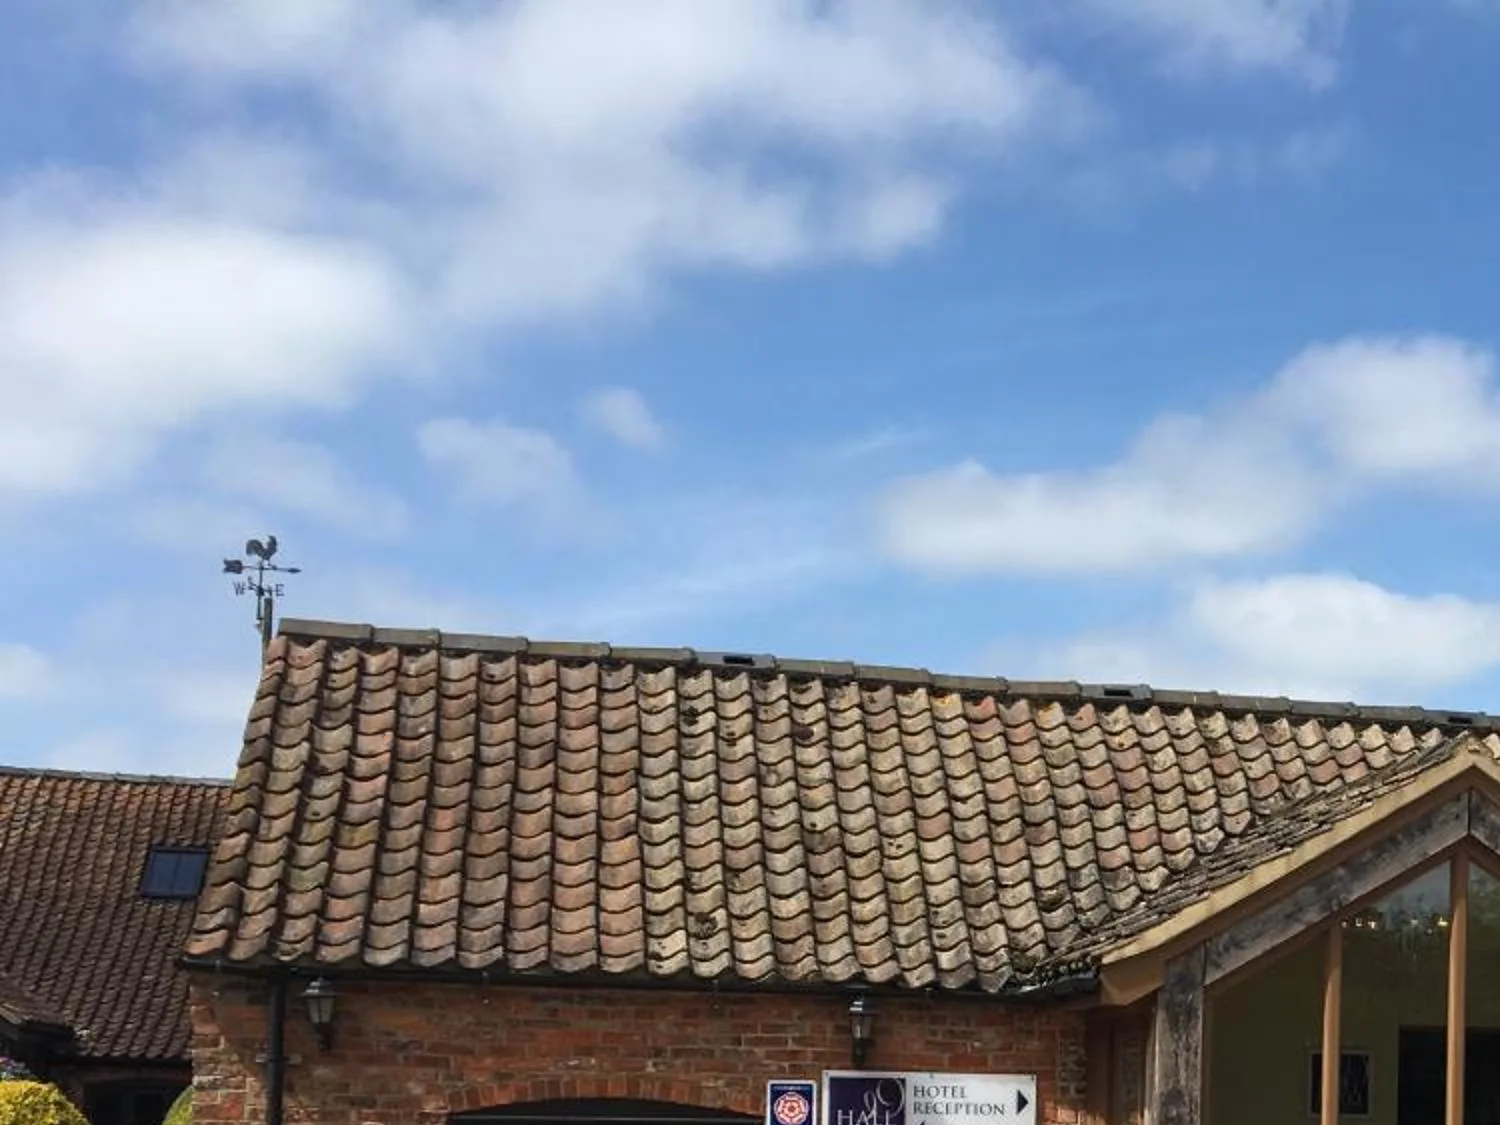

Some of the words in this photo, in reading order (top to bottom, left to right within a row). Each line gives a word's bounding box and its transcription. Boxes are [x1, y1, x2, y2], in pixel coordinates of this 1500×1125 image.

[275, 583, 285, 597] E
[913, 1085, 967, 1099] HOTEL
[913, 1101, 1005, 1116] RECEPTION
